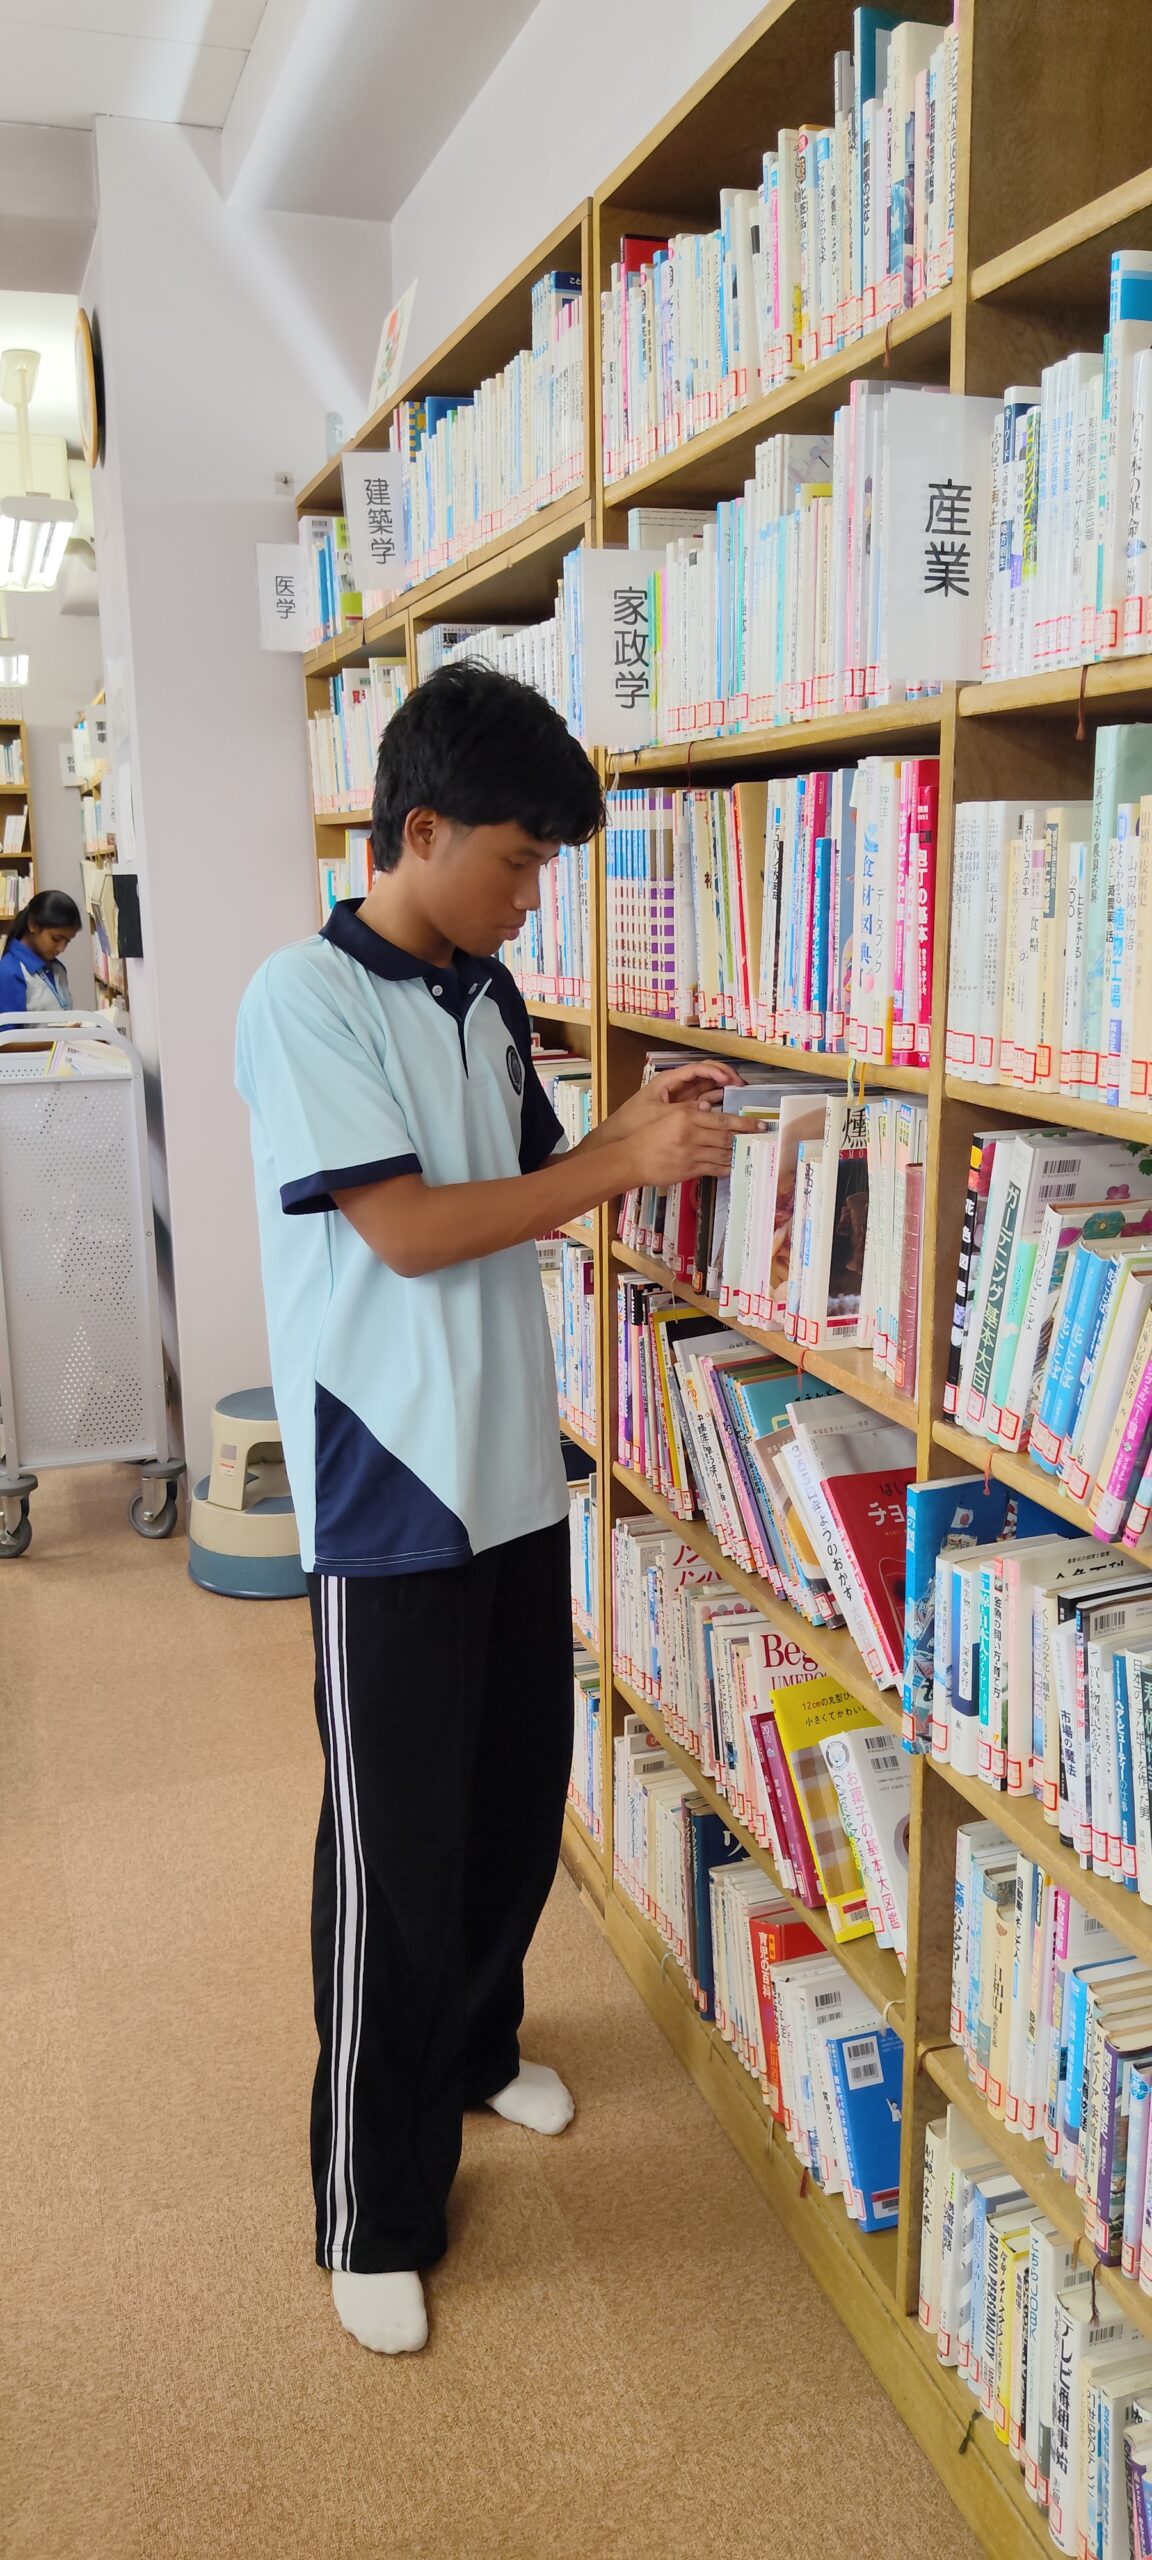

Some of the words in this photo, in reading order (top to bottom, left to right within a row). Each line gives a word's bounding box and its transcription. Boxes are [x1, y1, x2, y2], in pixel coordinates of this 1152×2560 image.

[364, 478, 396, 565] 建築学
[923, 478, 972, 598] 産業
[275, 575, 296, 619] 医学
[613, 586, 649, 710] 家政学
[917, 849, 929, 942] 包丁の基本
[1022, 824, 1033, 896] おいしいコメの本
[860, 855, 874, 965] 食材図典
[874, 888, 884, 973] データブック
[840, 1107, 867, 1149] 燻
[1060, 1709, 1077, 1778] 市場の魔法
[847, 1771, 901, 1931] お菓子の基本大図鑑
[758, 1931, 772, 1999] 育児の百科
[823, 2090, 838, 2145] 育児クイズ
[986, 2230, 999, 2275] RADIO
[983, 2277, 998, 2362] PERSONALITY
[1056, 2316, 1074, 2476] テレビ番組事始
